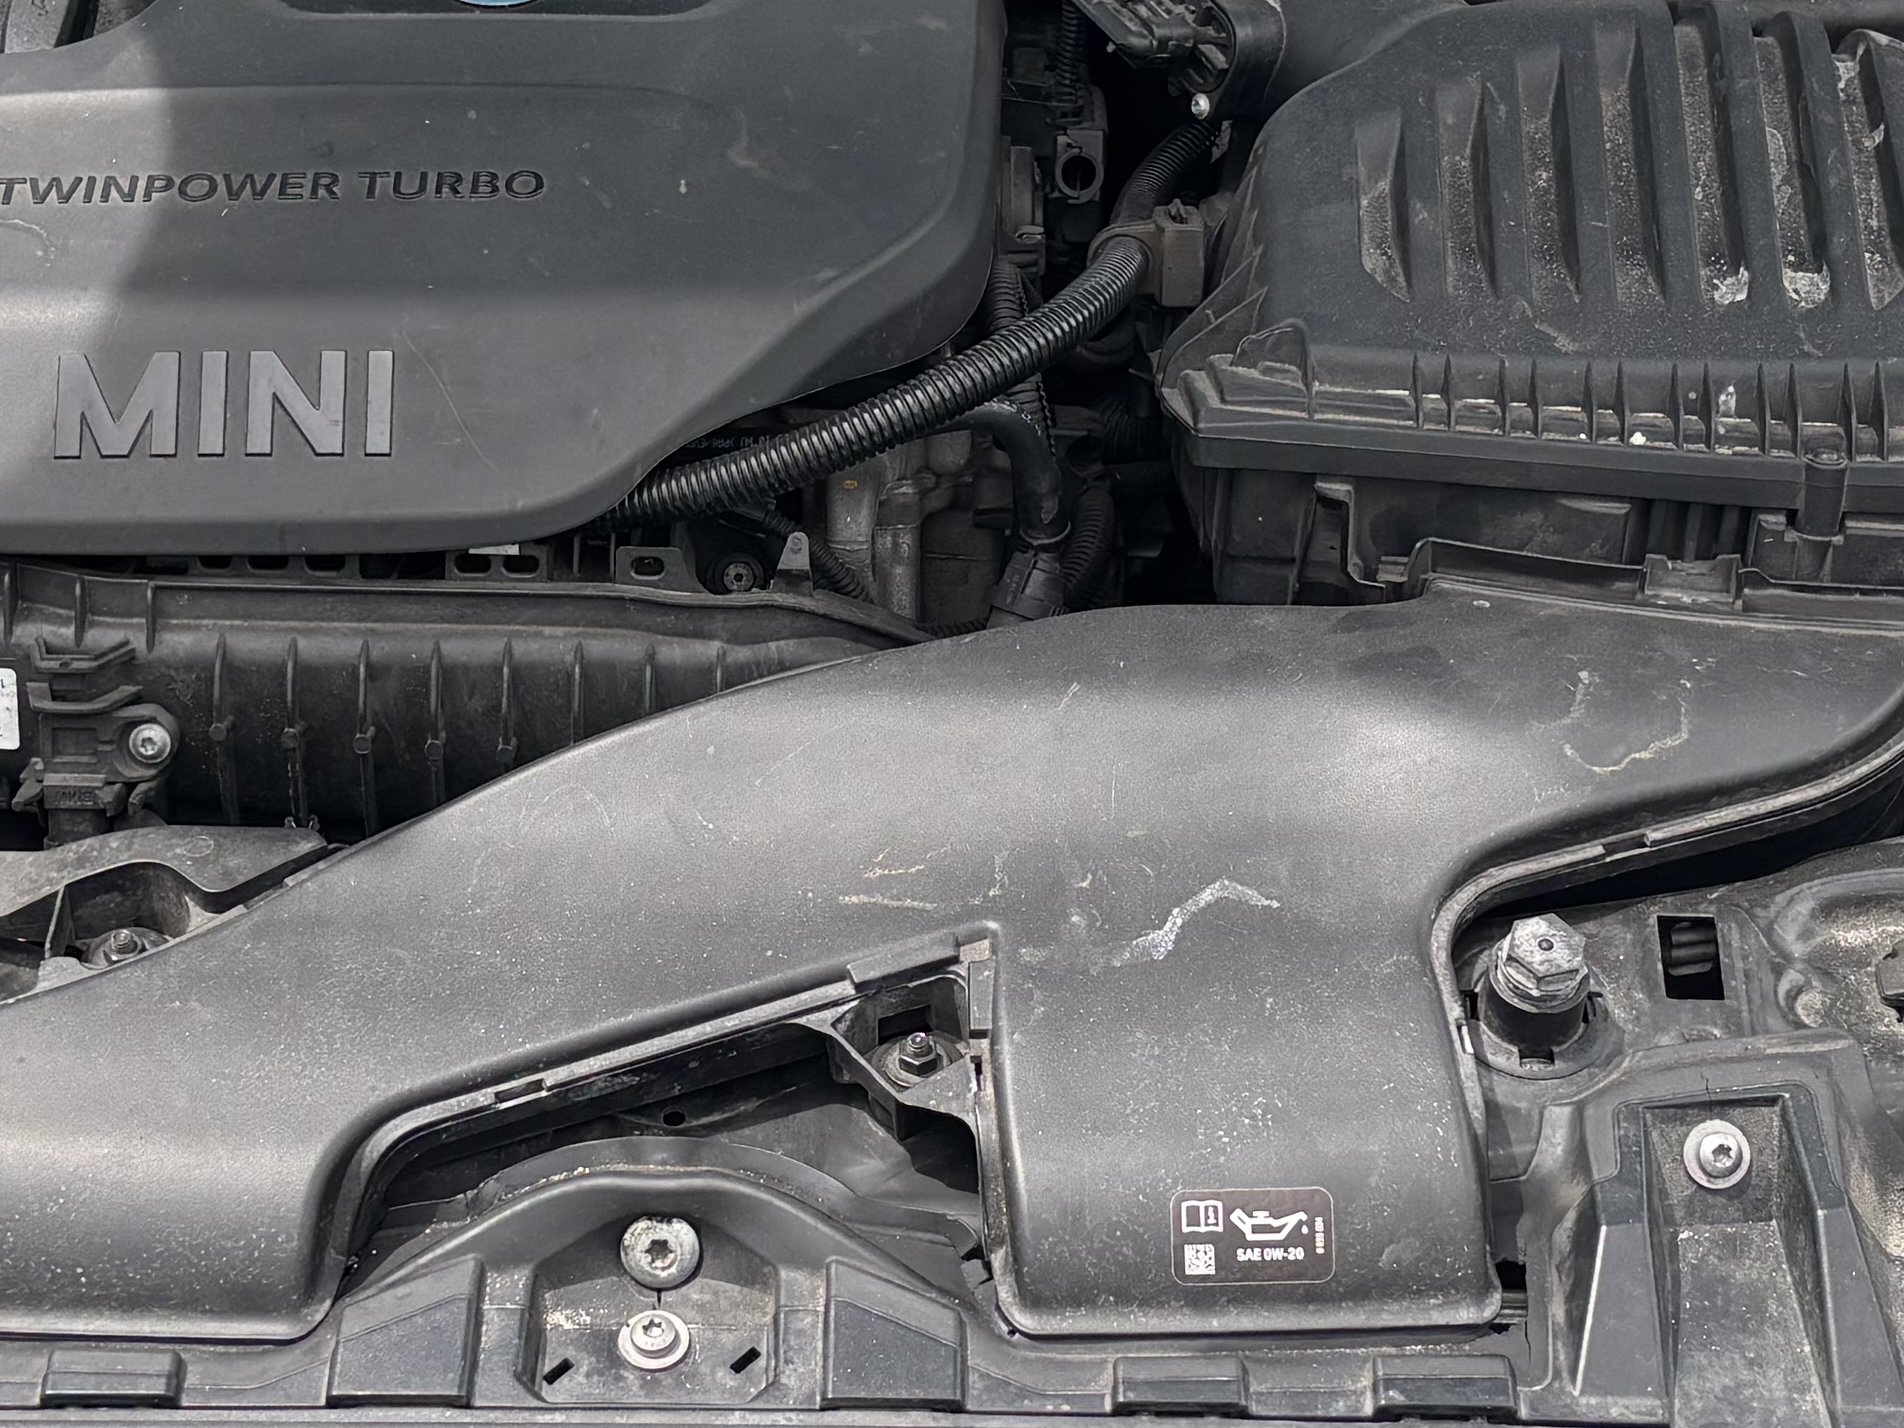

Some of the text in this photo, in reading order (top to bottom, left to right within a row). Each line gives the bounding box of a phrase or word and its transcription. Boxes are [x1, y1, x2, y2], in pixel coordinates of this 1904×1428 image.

[357, 170, 546, 200] TURBO
[53, 350, 395, 460] MINI
[1237, 1247, 1305, 1262] SAE 0W-20
